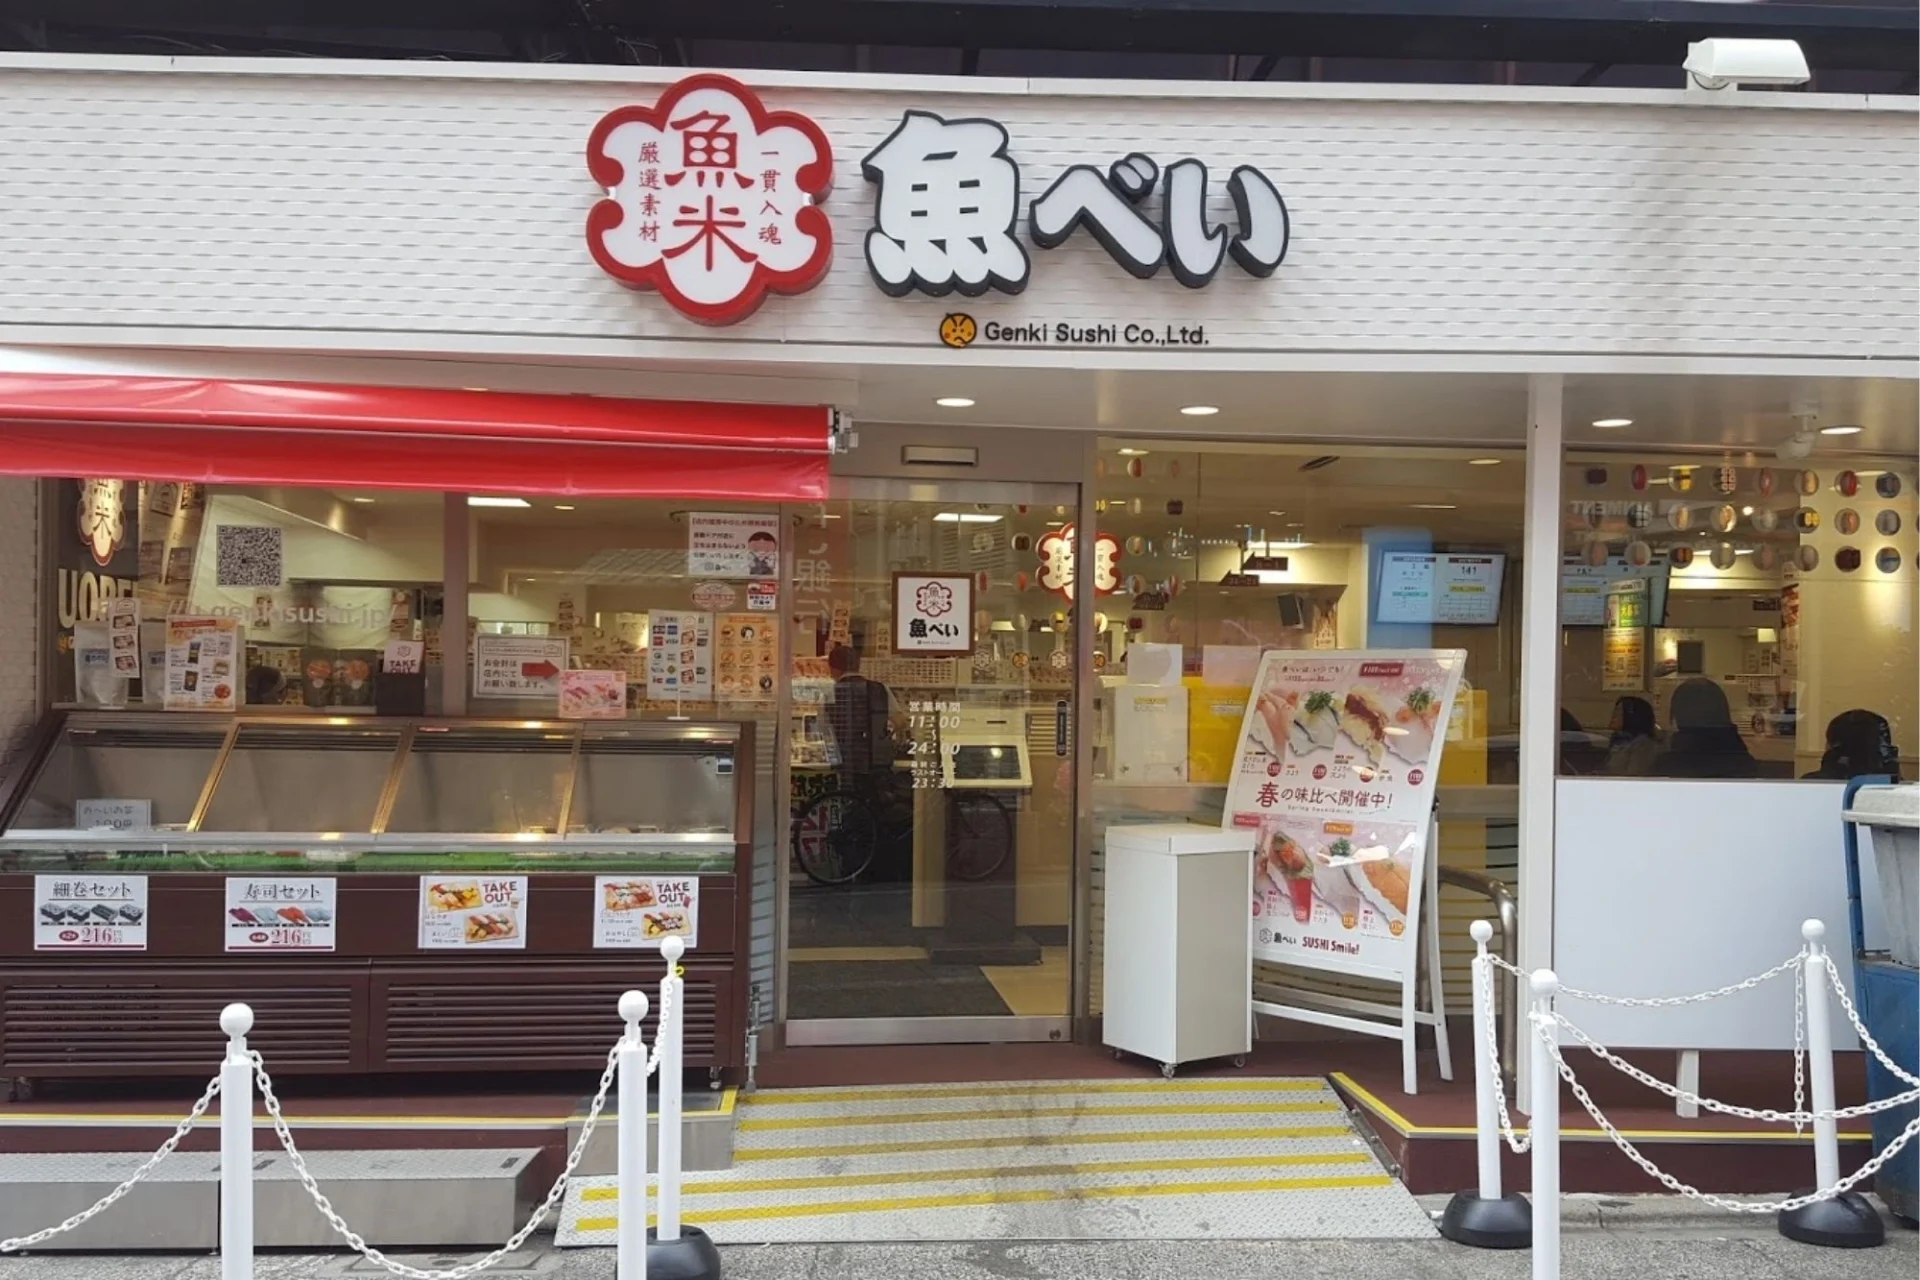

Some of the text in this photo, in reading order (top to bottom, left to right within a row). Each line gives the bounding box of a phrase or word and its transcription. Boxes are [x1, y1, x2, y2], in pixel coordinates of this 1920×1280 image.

[637, 140, 662, 244] 厳選素材
[664, 109, 758, 271] 魚米
[758, 150, 784, 247] 一貫入魂
[861, 109, 1291, 297] 魚べい
[984, 321, 1210, 346] Genki Sushi Co.,Ltd.
[909, 618, 959, 638] 魚べい
[389, 659, 417, 668] TAKE
[908, 701, 961, 713] 営業時間
[908, 715, 961, 728] 11:00
[907, 742, 961, 755] 24:00
[911, 777, 955, 789] 23:30
[52, 881, 131, 898] 細巻セット
[245, 882, 321, 900] 寿司セット
[482, 880, 518, 893] TAKE
[657, 881, 691, 893] TAKE
[484, 892, 513, 904] OUT
[658, 892, 685, 904] OUT
[81, 927, 113, 943] 216
[271, 929, 301, 944] 216
[1302, 936, 1360, 955] SUSHI Smile!
